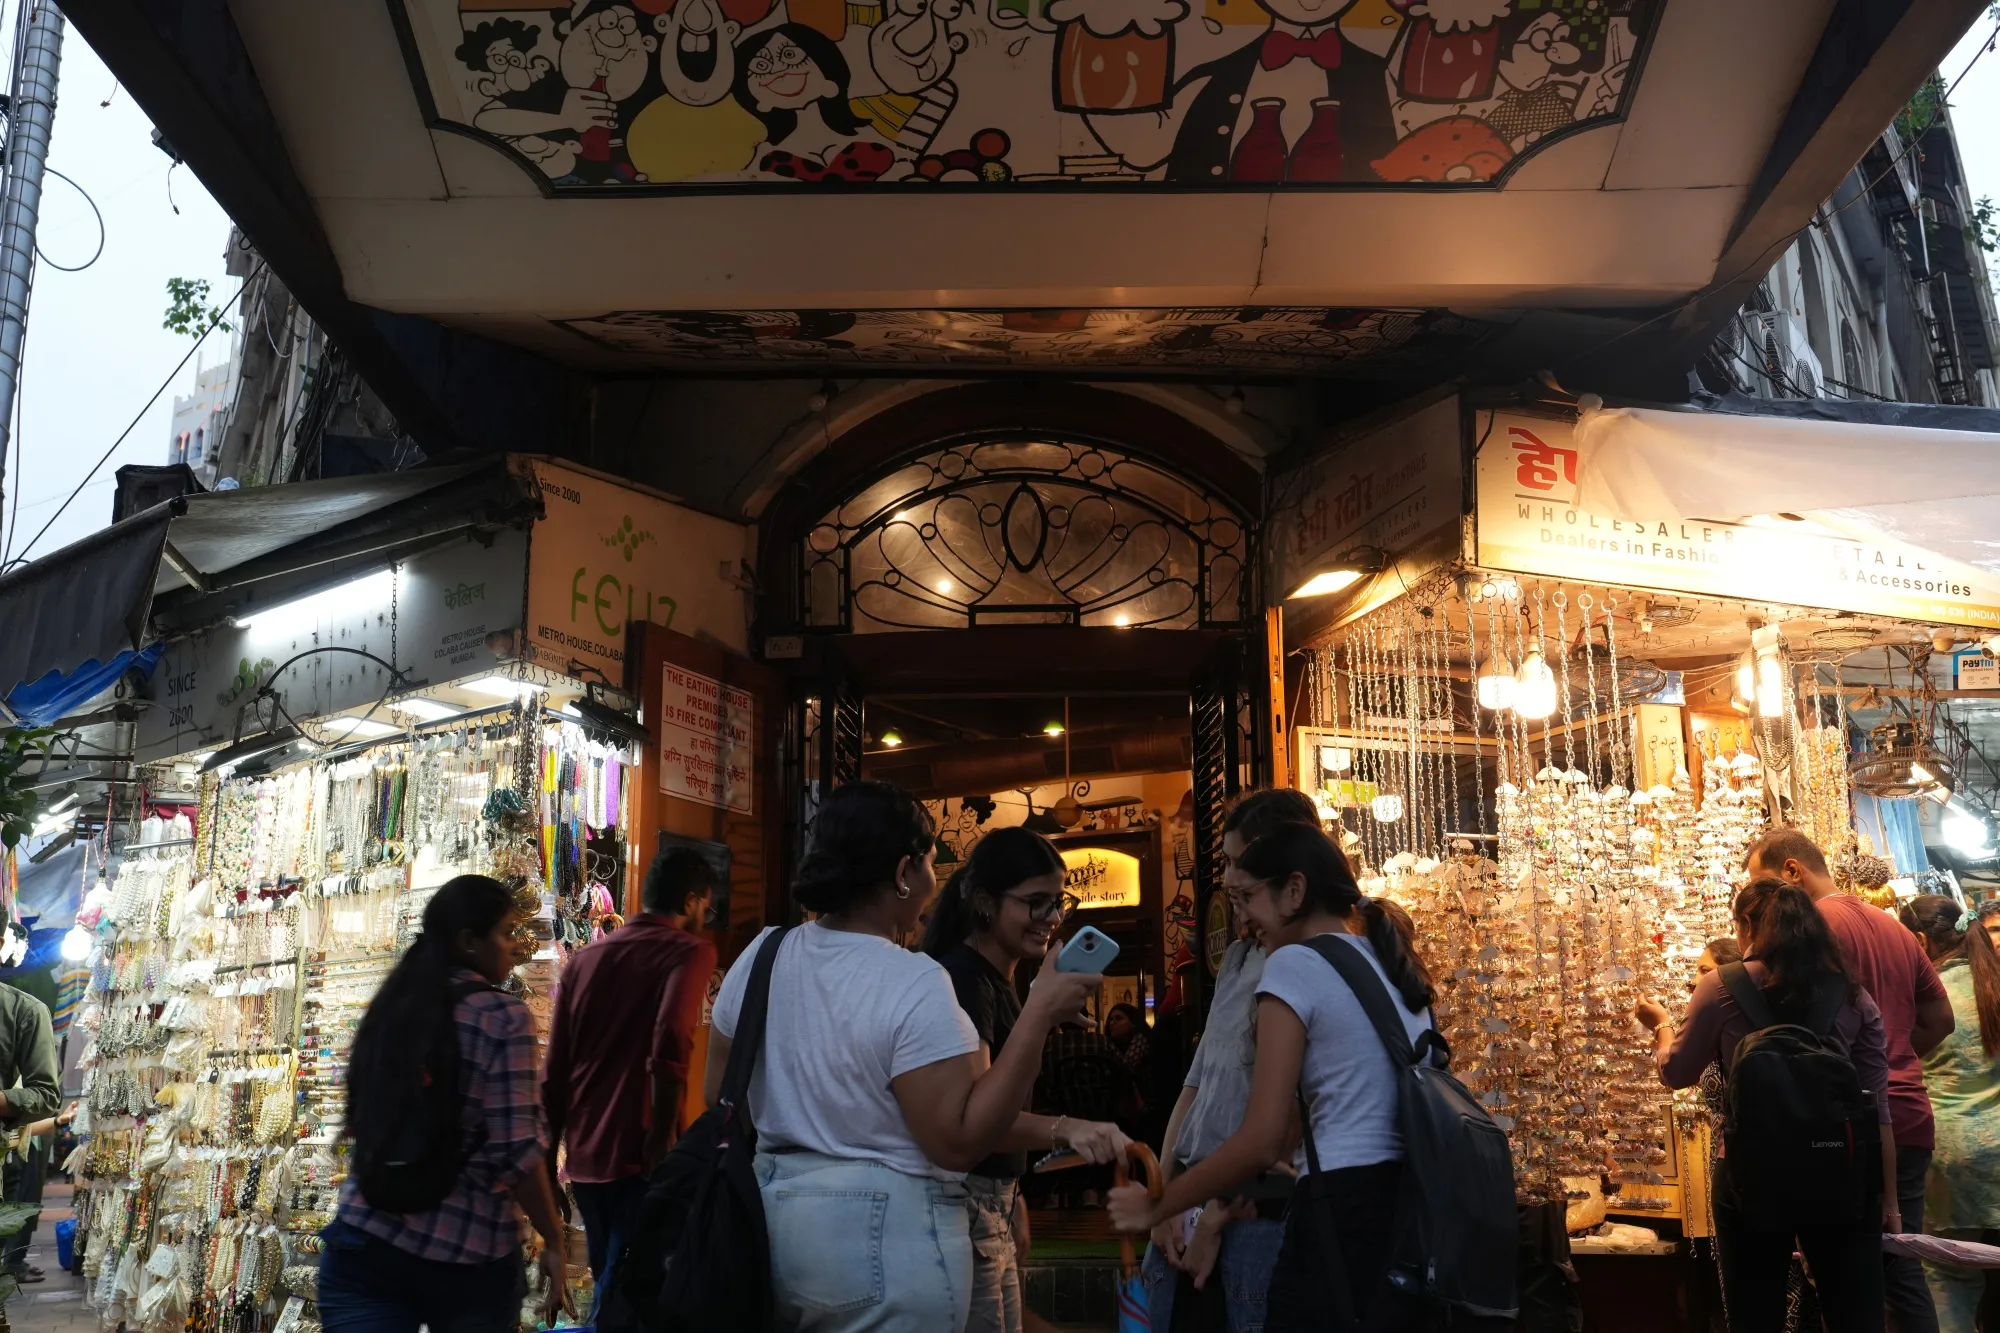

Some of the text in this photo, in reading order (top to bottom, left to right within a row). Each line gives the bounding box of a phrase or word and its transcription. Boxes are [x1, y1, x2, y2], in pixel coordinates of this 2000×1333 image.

[539, 477, 581, 504] Since 2000
[1517, 503, 1736, 545] WHOLESALER
[1540, 528, 1618, 552] Dealers
[1627, 540, 1644, 555] in
[1856, 570, 1972, 597] Accessories
[441, 631, 463, 646] METRO
[538, 624, 565, 646] METRO
[433, 644, 459, 659] COLABA
[168, 671, 196, 697] SINCE
[666, 669, 748, 710] THE EATING HOUSE
[169, 704, 194, 728] 2000
[686, 694, 729, 719] PREMISES
[665, 704, 747, 742] IS FIRE COMPLIANT
[690, 737, 698, 751] हा
[1100, 891, 1127, 904] story
[1811, 1140, 1845, 1148] Lenovo
